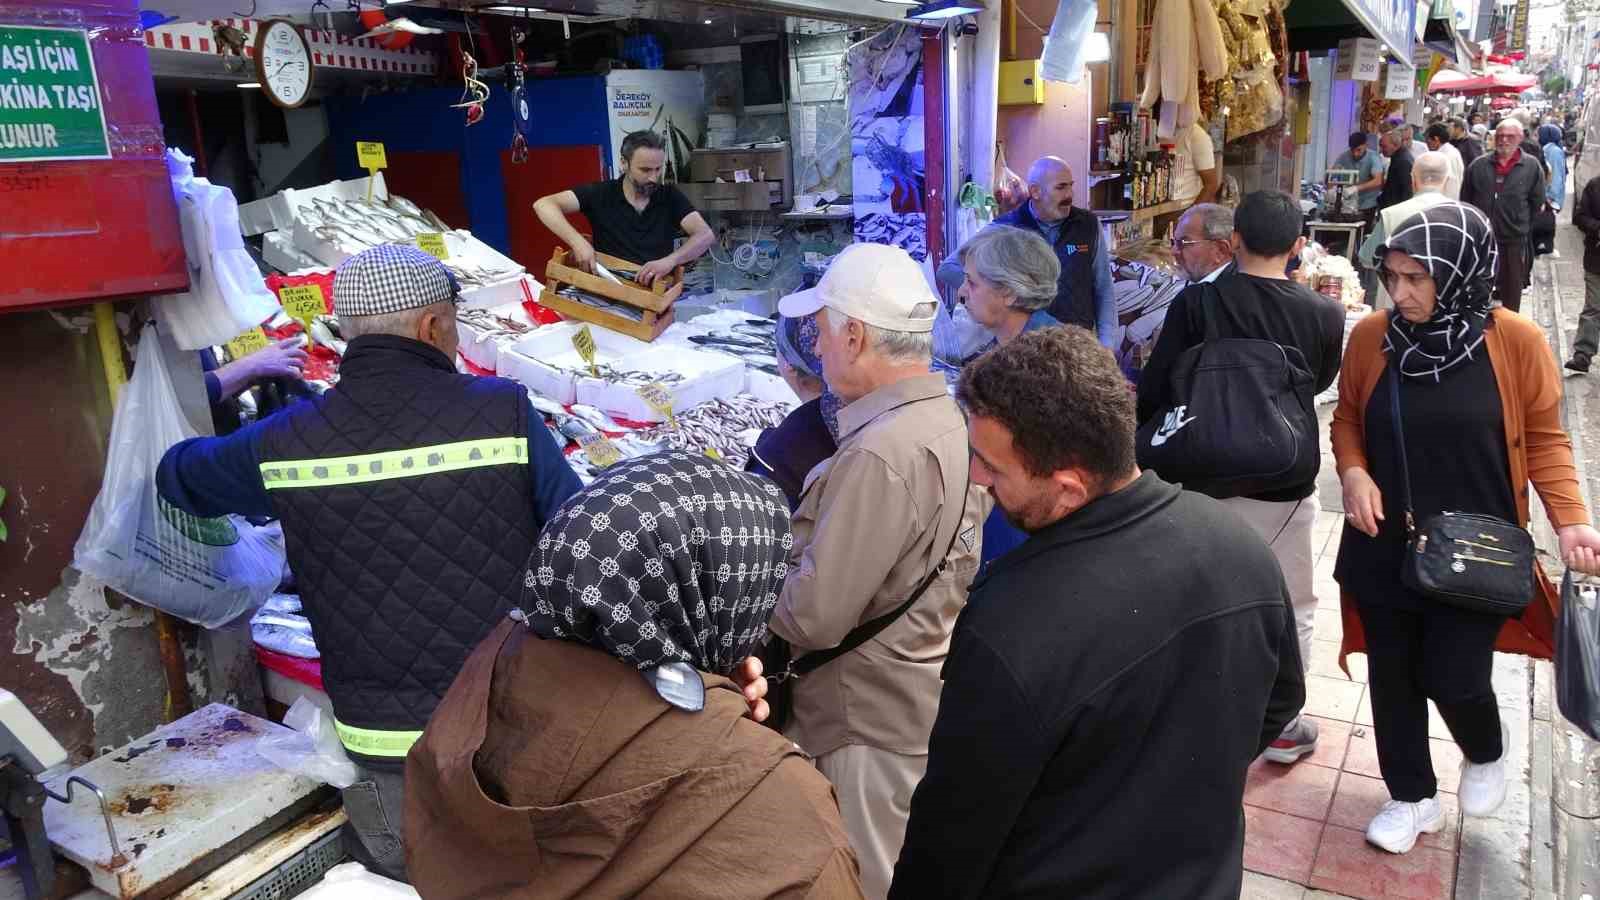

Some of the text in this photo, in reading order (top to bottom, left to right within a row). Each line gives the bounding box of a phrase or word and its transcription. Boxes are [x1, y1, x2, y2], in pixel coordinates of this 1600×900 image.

[2, 39, 79, 74] AŞI İÇİN
[0, 78, 97, 112] KİNA TAŞI
[1160, 405, 1187, 432] NIKE
